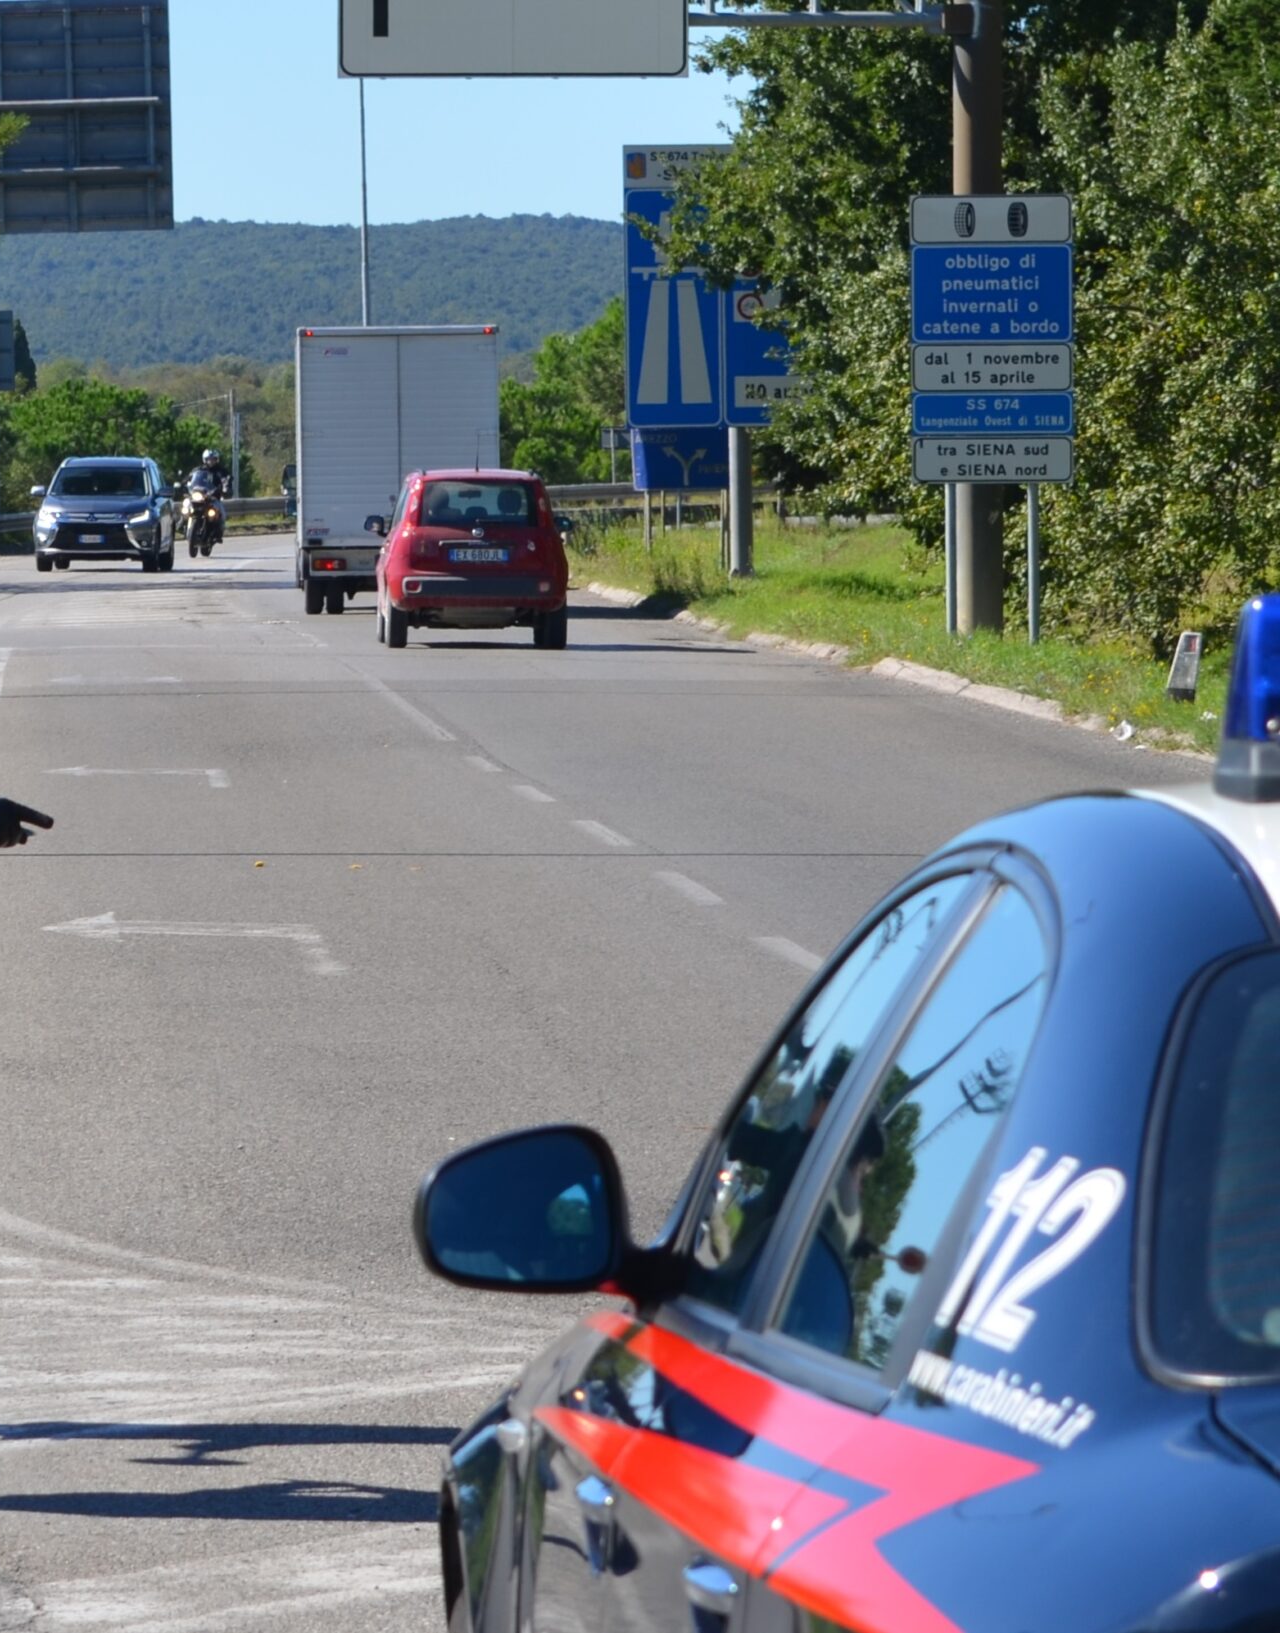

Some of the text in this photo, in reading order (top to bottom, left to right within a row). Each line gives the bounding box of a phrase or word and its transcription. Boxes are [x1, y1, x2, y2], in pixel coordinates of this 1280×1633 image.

[945, 254, 1036, 271] obbligo di
[941, 275, 1039, 293] pneumatici
[943, 298, 1039, 313] invernali o
[922, 319, 1060, 334] catene a bordo
[924, 352, 1060, 365] dal 1 novembre
[941, 371, 1035, 386] al 15 aprile
[966, 399, 1020, 410] SS 674
[921, 417, 978, 428] tangenziale
[1018, 415, 1028, 426] di
[1035, 415, 1064, 426] SIENA
[937, 444, 1049, 456] tra SIENA sud
[940, 464, 1047, 476] e SIENA nord
[934, 1146, 1126, 1353] 112
[907, 1348, 1096, 1449] www.carabinieri.it
